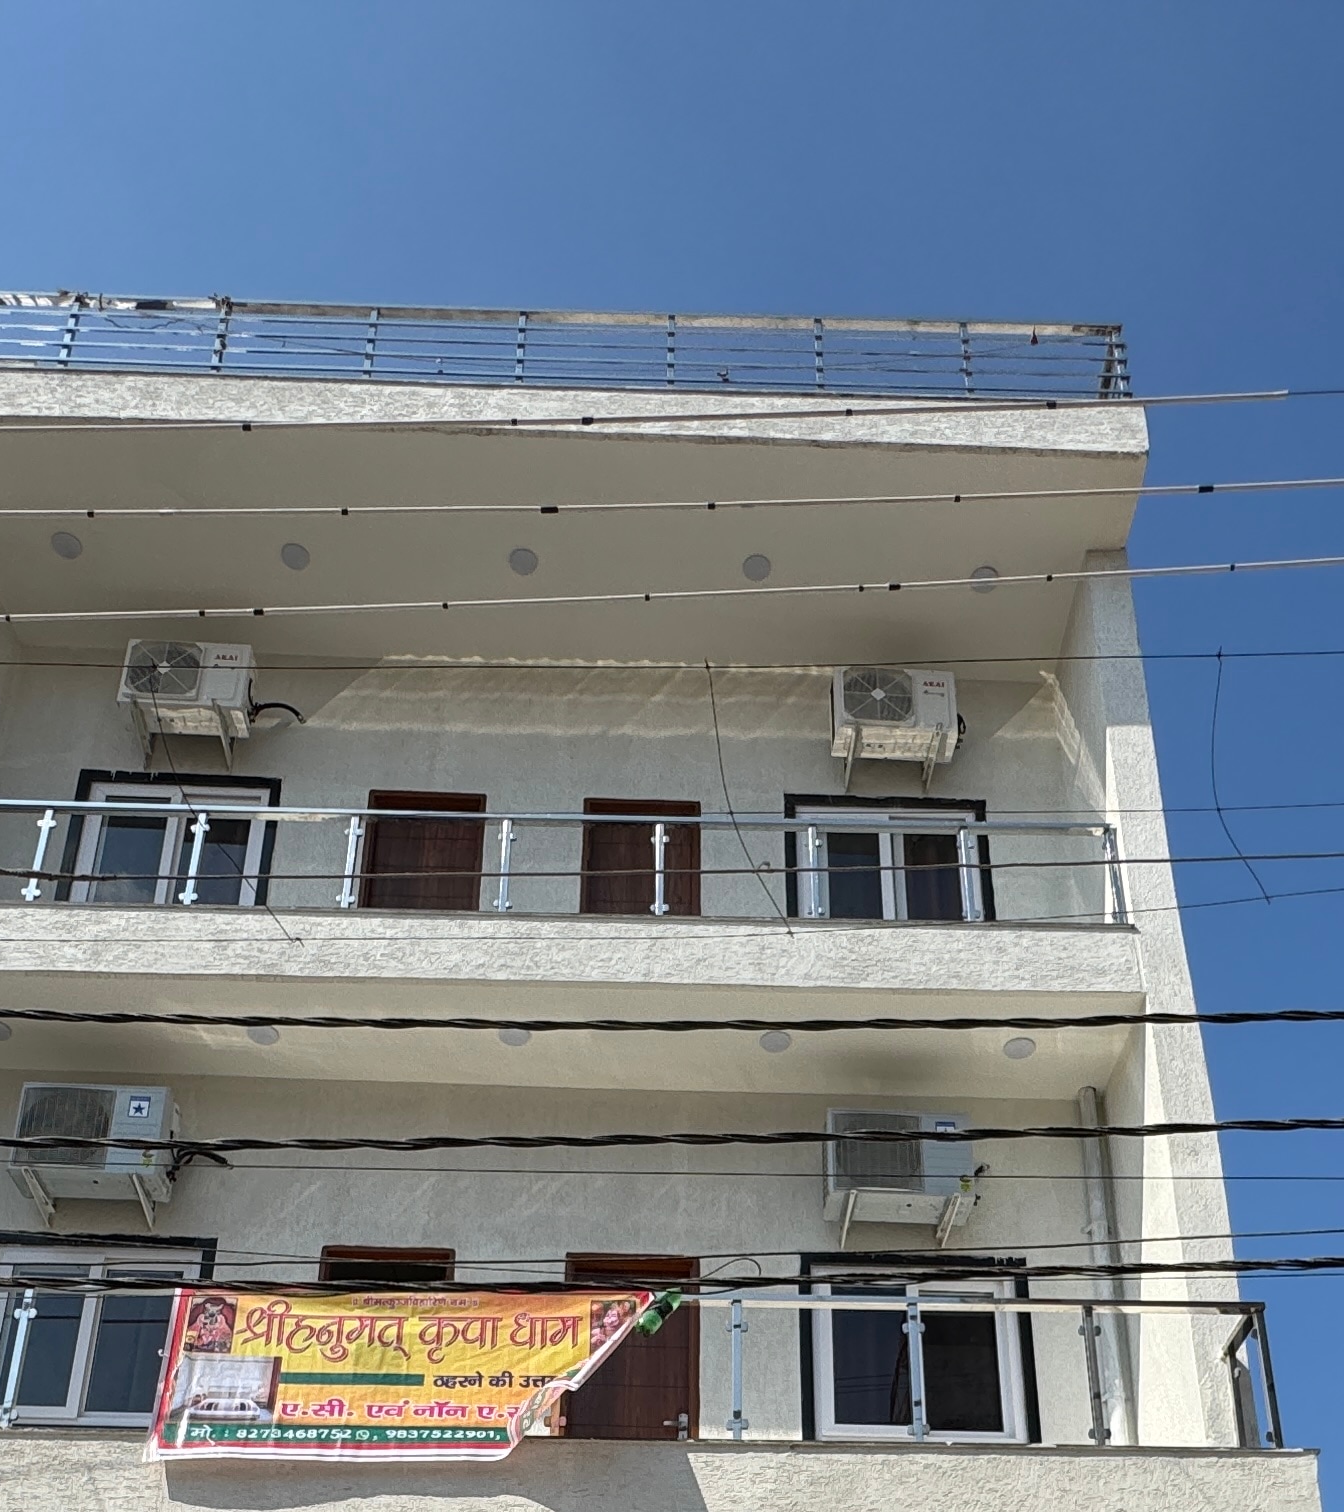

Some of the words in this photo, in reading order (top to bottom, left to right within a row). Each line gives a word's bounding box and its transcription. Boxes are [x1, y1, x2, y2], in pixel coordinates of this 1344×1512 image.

[214, 653, 239, 662] AKAI
[922, 680, 945, 688] AKAI
[235, 1299, 411, 1363] श्रीहनुमत्
[418, 1316, 503, 1364] कृपा
[510, 1312, 583, 1350] धाम
[488, 1370, 513, 1388] की
[367, 1400, 410, 1418] एवं
[413, 1401, 468, 1418] नॉन
